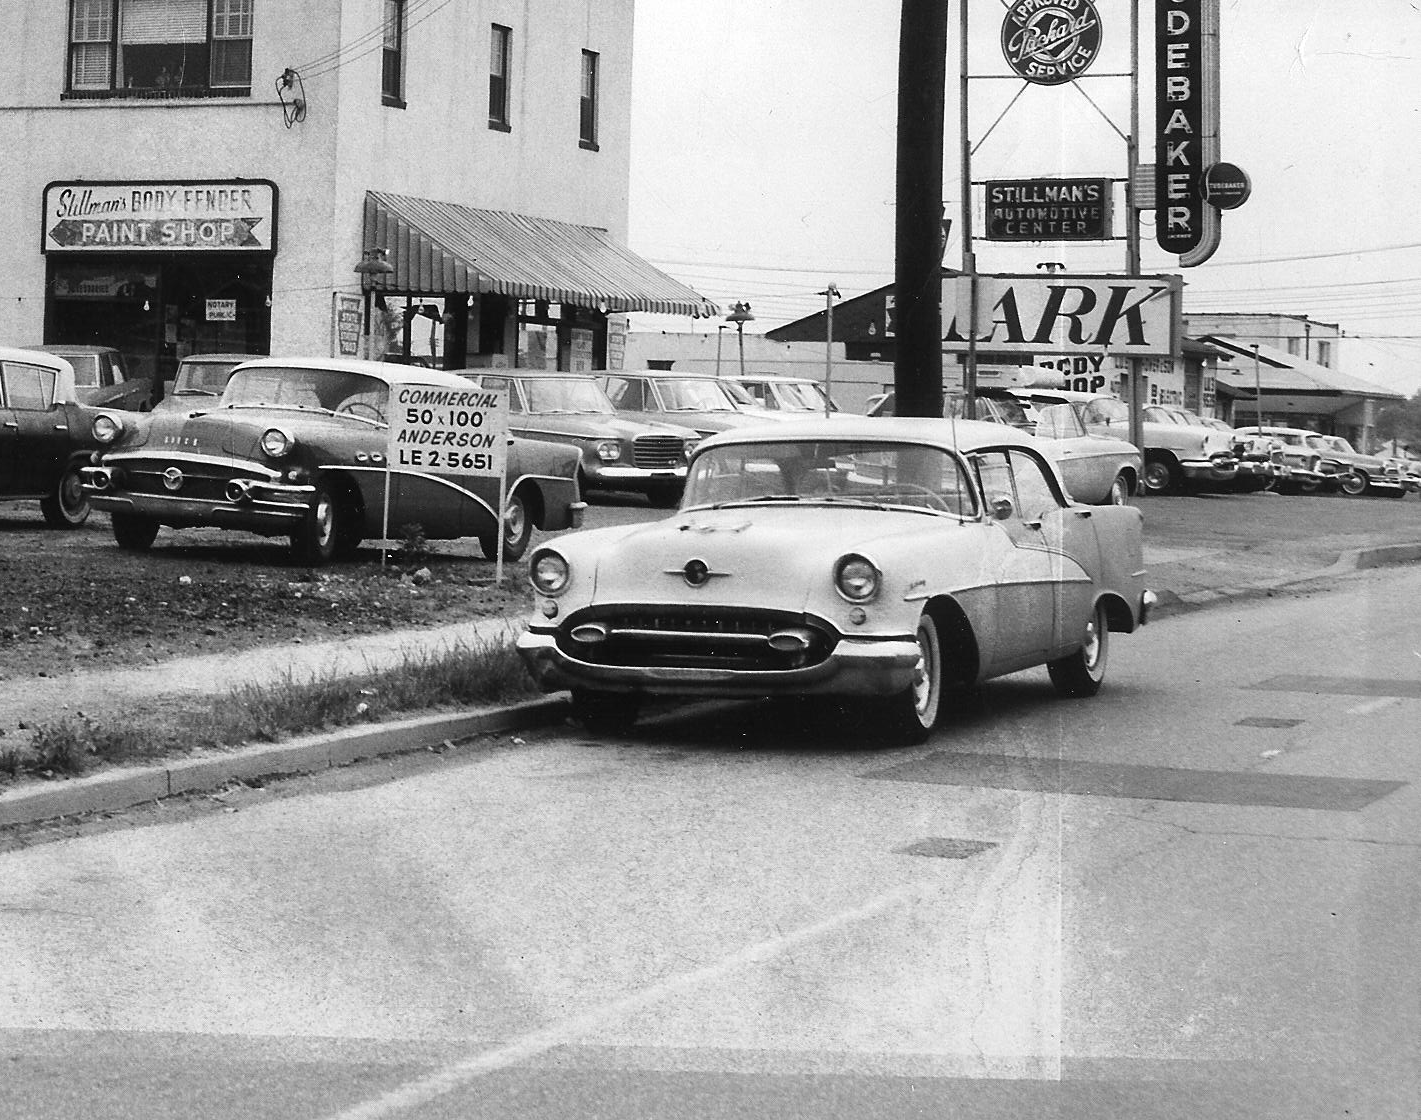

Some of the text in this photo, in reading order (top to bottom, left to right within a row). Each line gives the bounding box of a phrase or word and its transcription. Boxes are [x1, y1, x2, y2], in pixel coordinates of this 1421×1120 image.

[1007, 6, 1097, 64] Packard
[1025, 45, 1093, 77] SERVICE
[991, 184, 1100, 203] STILLMAN'S
[994, 207, 1099, 220] AUTOMOTIVE
[81, 223, 235, 243] PAINT SHOP
[1005, 221, 1087, 234] CENTER
[208, 301, 234, 309] NOTARY
[398, 389, 498, 408] COMMERCIAL
[397, 429, 496, 448] ANDERSON
[399, 449, 423, 466] LE
